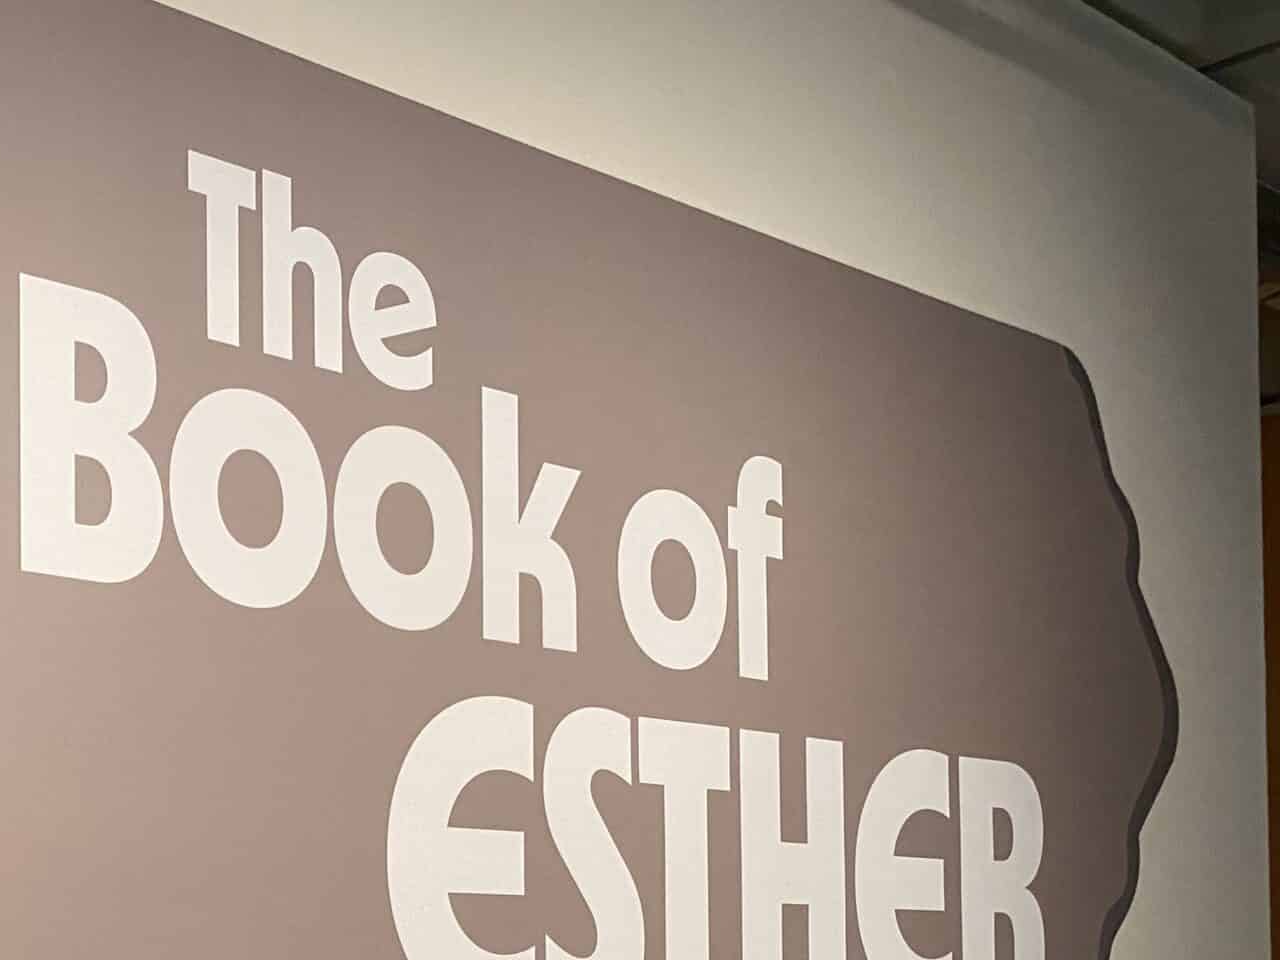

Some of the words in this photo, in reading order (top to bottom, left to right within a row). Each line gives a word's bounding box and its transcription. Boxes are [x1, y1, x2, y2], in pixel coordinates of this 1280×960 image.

[188, 149, 437, 391] The
[19, 271, 581, 653] Book
[617, 455, 784, 681] of
